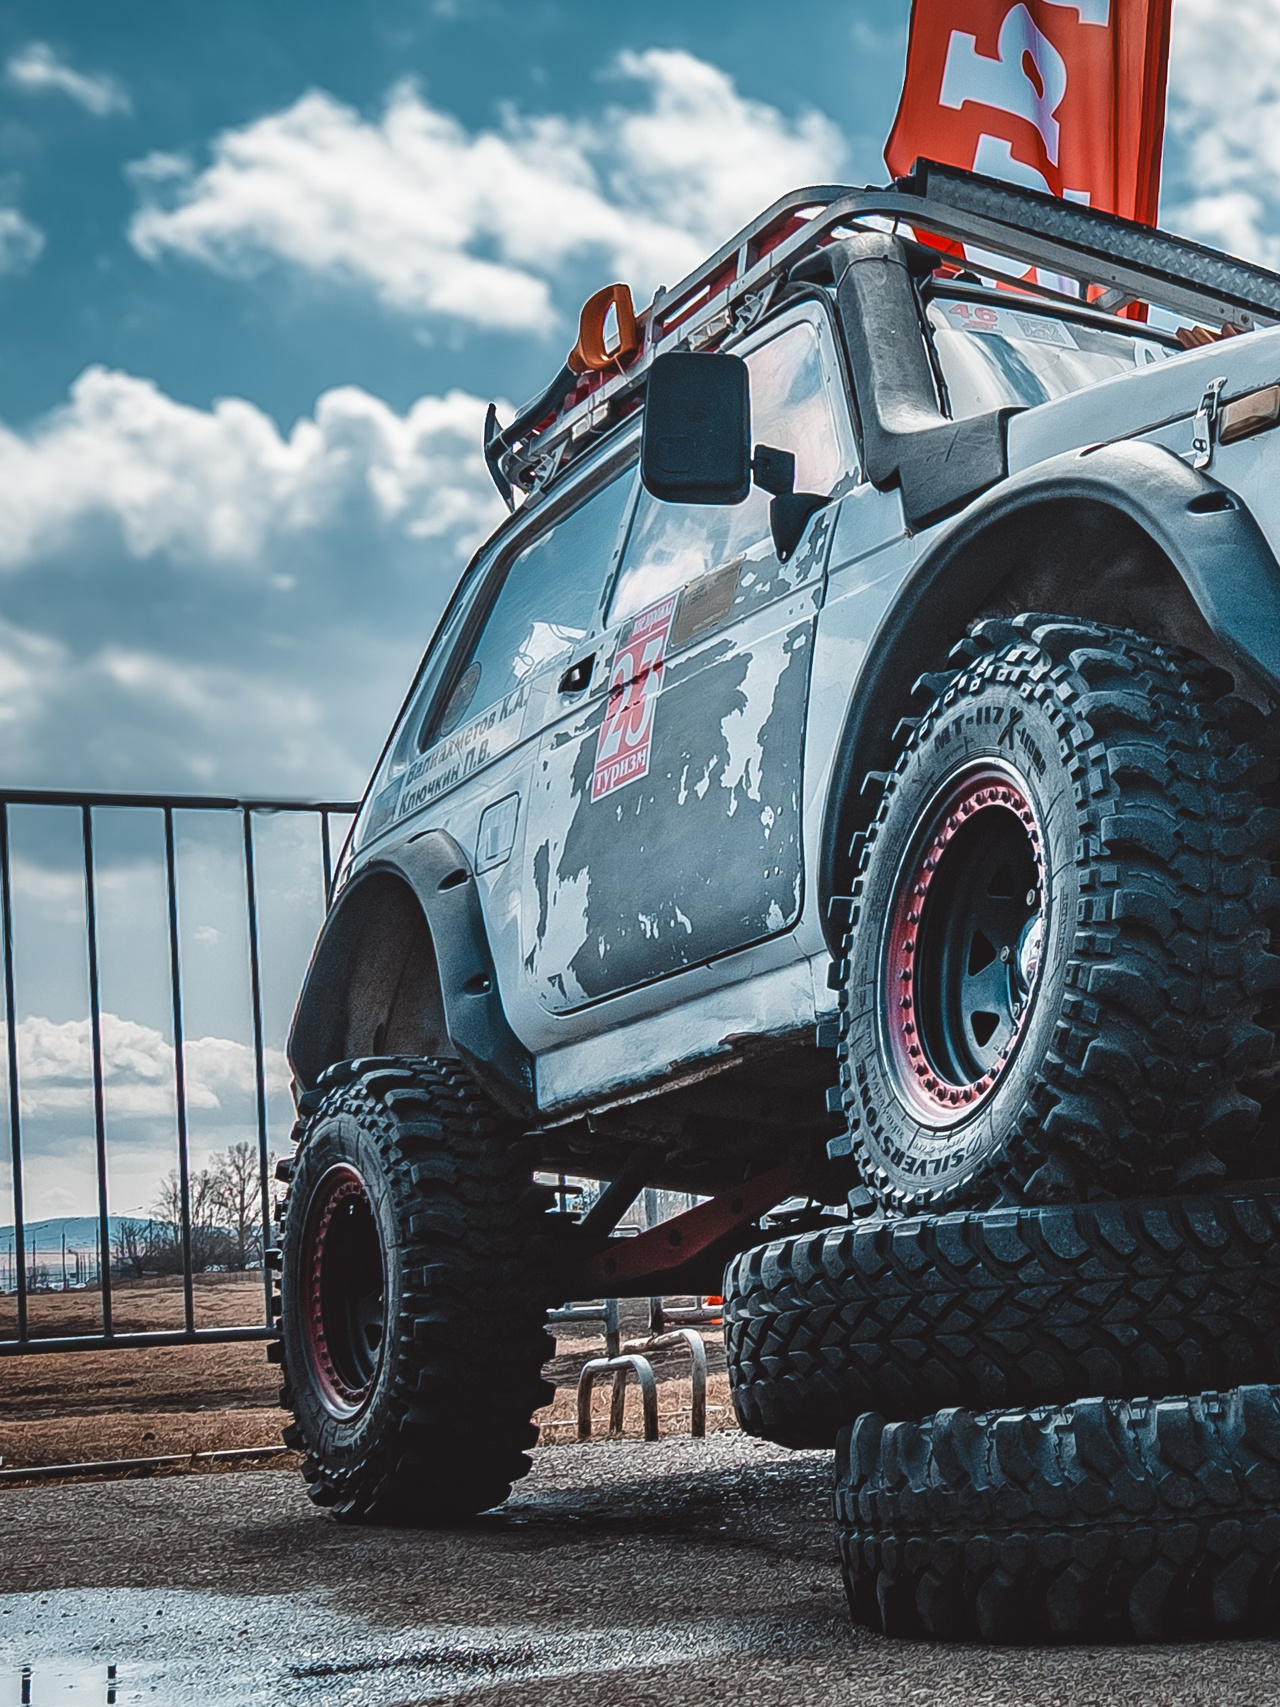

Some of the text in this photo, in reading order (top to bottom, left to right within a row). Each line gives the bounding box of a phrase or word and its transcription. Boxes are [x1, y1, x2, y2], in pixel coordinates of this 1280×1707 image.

[934, 706, 1004, 754] MT-117
[397, 737, 491, 818] Ключкин П.В.
[855, 1058, 968, 1178] SILVERSTONE
